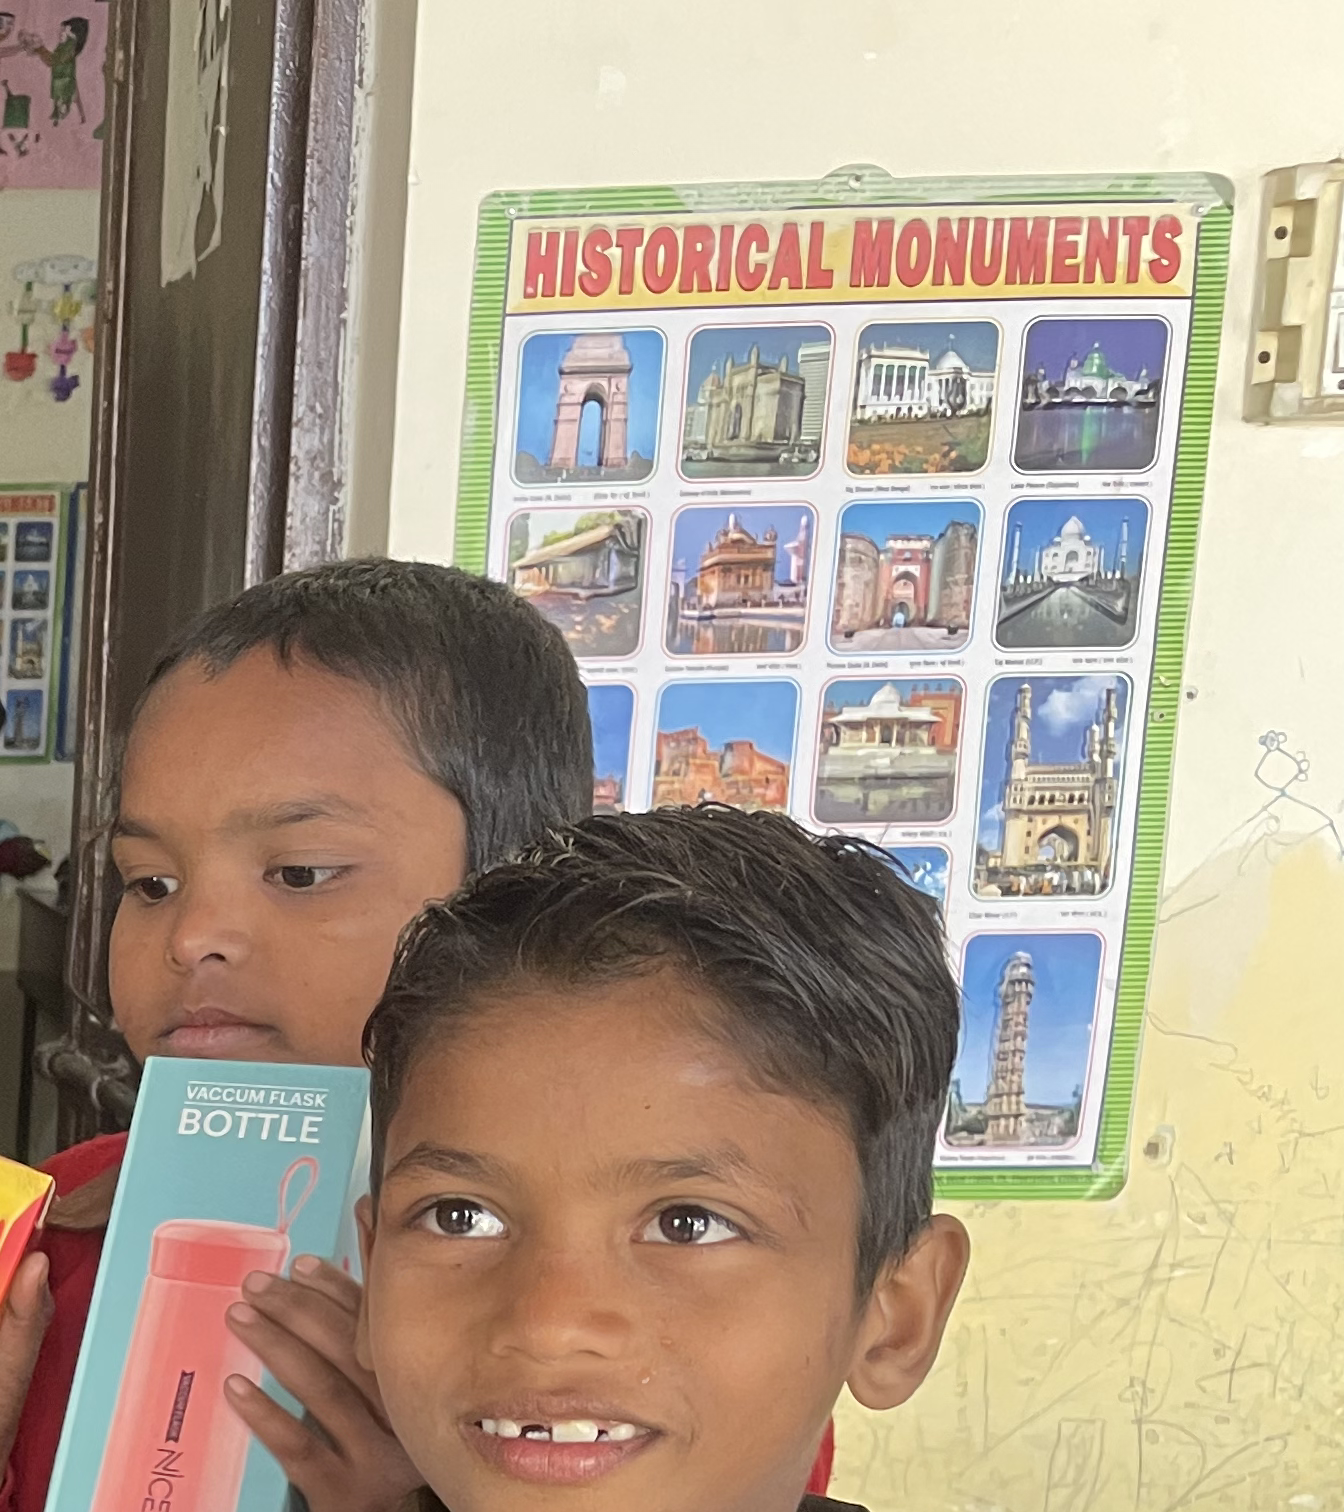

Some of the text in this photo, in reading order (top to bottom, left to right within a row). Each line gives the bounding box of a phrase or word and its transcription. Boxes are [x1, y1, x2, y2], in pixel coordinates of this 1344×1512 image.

[523, 213, 1185, 299] HISTORICAL MONUMENTS
[187, 1086, 328, 1108] VACCUM FLASK
[178, 1108, 323, 1144] BOTTLE
